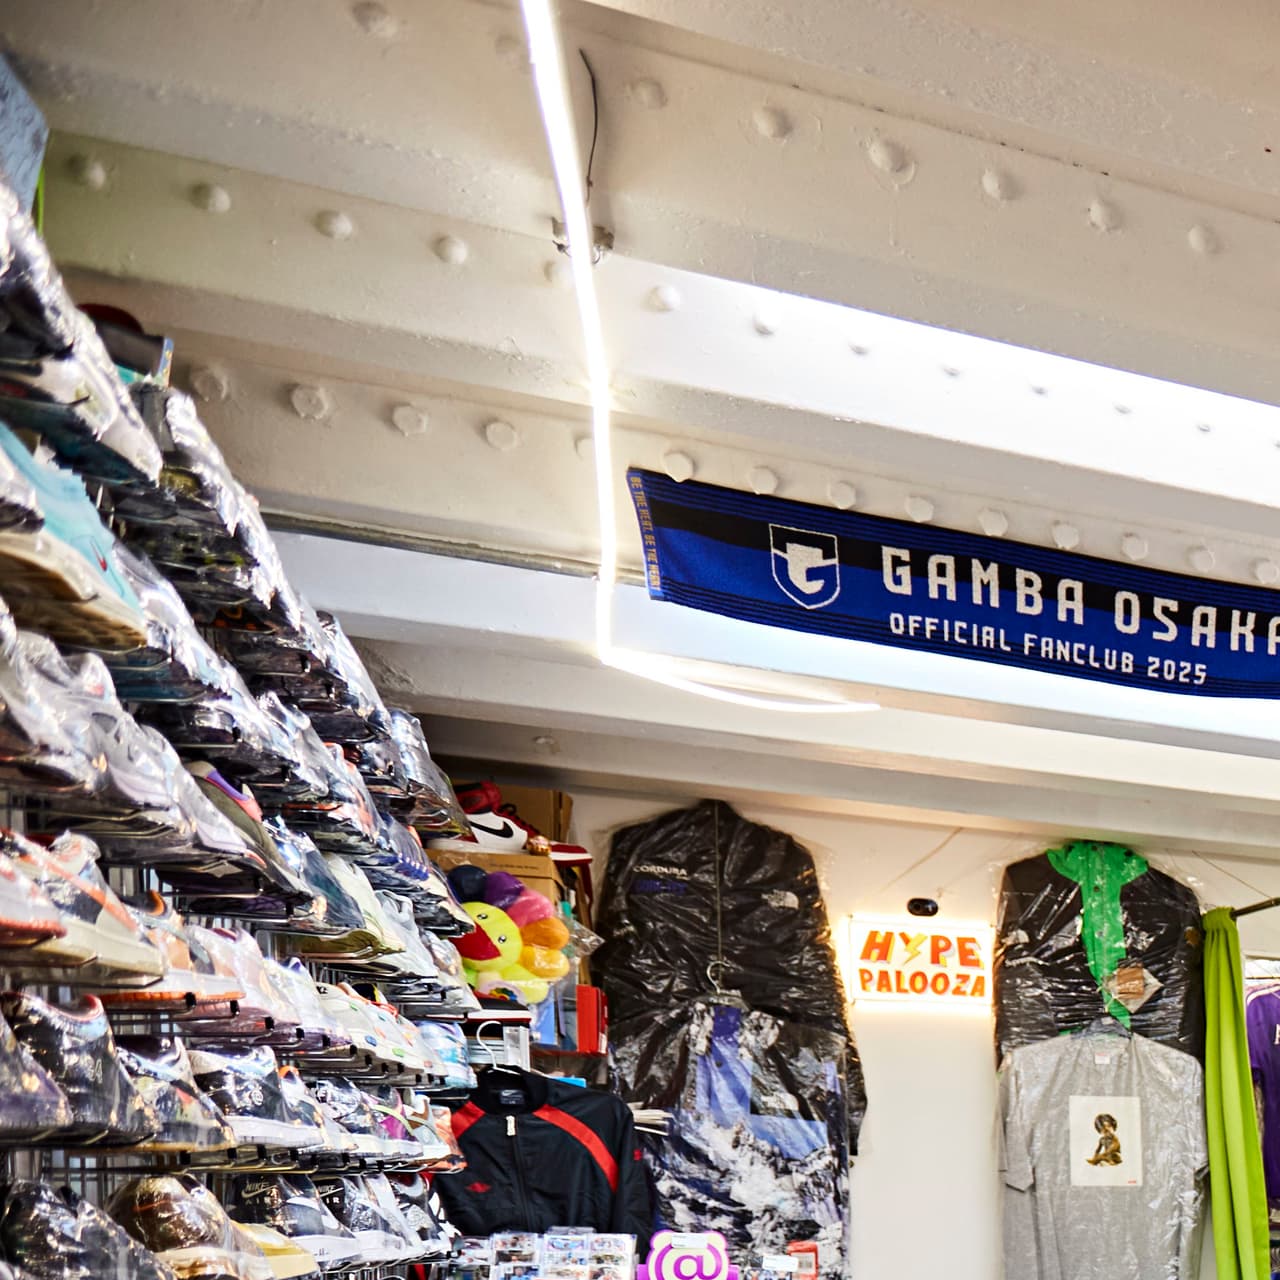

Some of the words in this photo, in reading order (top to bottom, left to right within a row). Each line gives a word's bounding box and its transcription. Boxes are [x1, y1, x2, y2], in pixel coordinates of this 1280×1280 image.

[882, 546, 1084, 625] GAMBA
[889, 613, 1012, 651] OFFICIAL
[1024, 632, 1135, 673] FANCLUB
[1147, 655, 1207, 685] 2025
[633, 864, 688, 877] CORDURA
[859, 930, 984, 970] HYPE
[858, 968, 986, 997] PALOOZA
